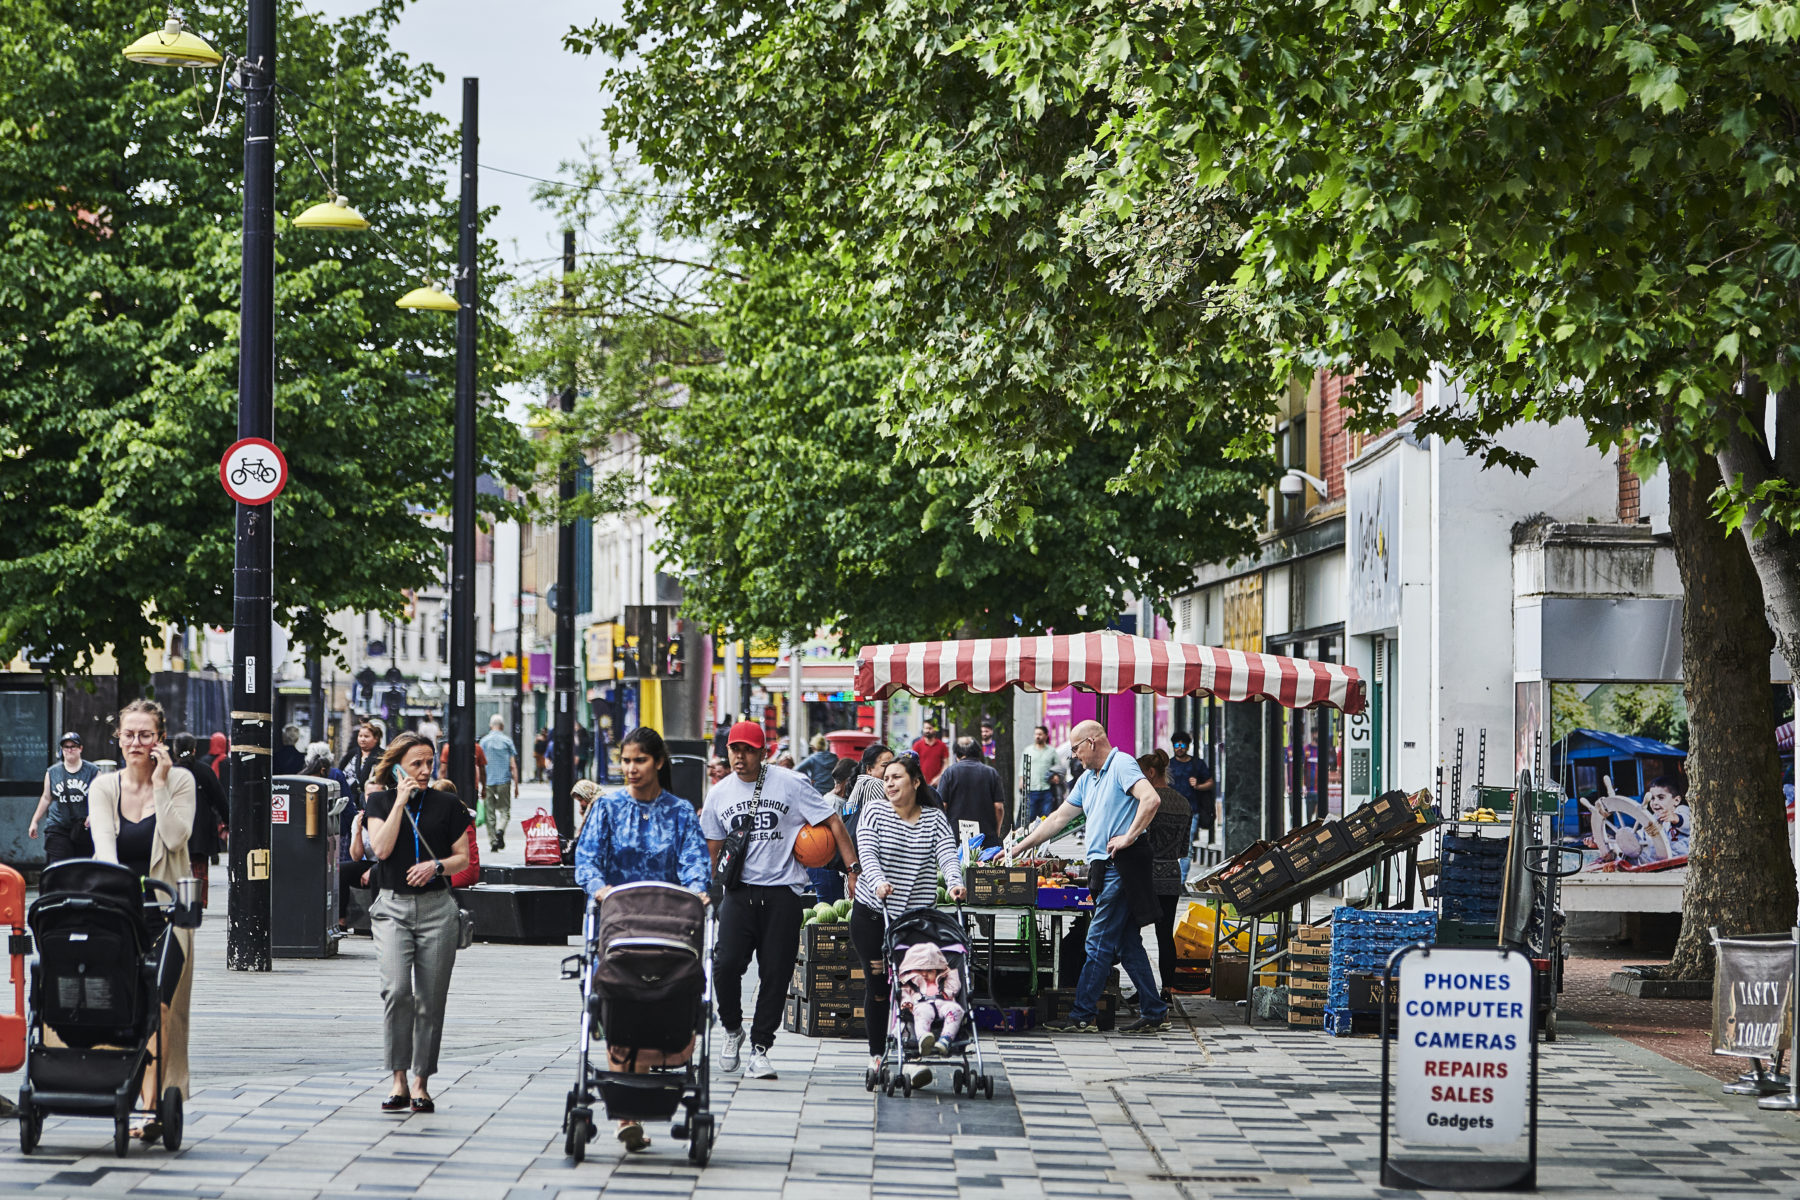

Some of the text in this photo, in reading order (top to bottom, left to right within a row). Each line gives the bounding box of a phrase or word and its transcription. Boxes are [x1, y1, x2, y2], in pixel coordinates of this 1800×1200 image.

[721, 799, 790, 821] THE STRNGHOLD
[738, 812, 771, 829] 195
[251, 852, 268, 877] H
[1424, 973, 1511, 991] PHONES
[1739, 981, 1779, 1005] TASTY
[1406, 1000, 1524, 1018] COMPUTER
[1414, 1031, 1517, 1050] CAMERAS
[1737, 1022, 1778, 1046] TOUCH
[1424, 1060, 1508, 1078] REPAIRS
[1430, 1085, 1494, 1104] SALES
[1426, 1112, 1494, 1131] Gadgets
